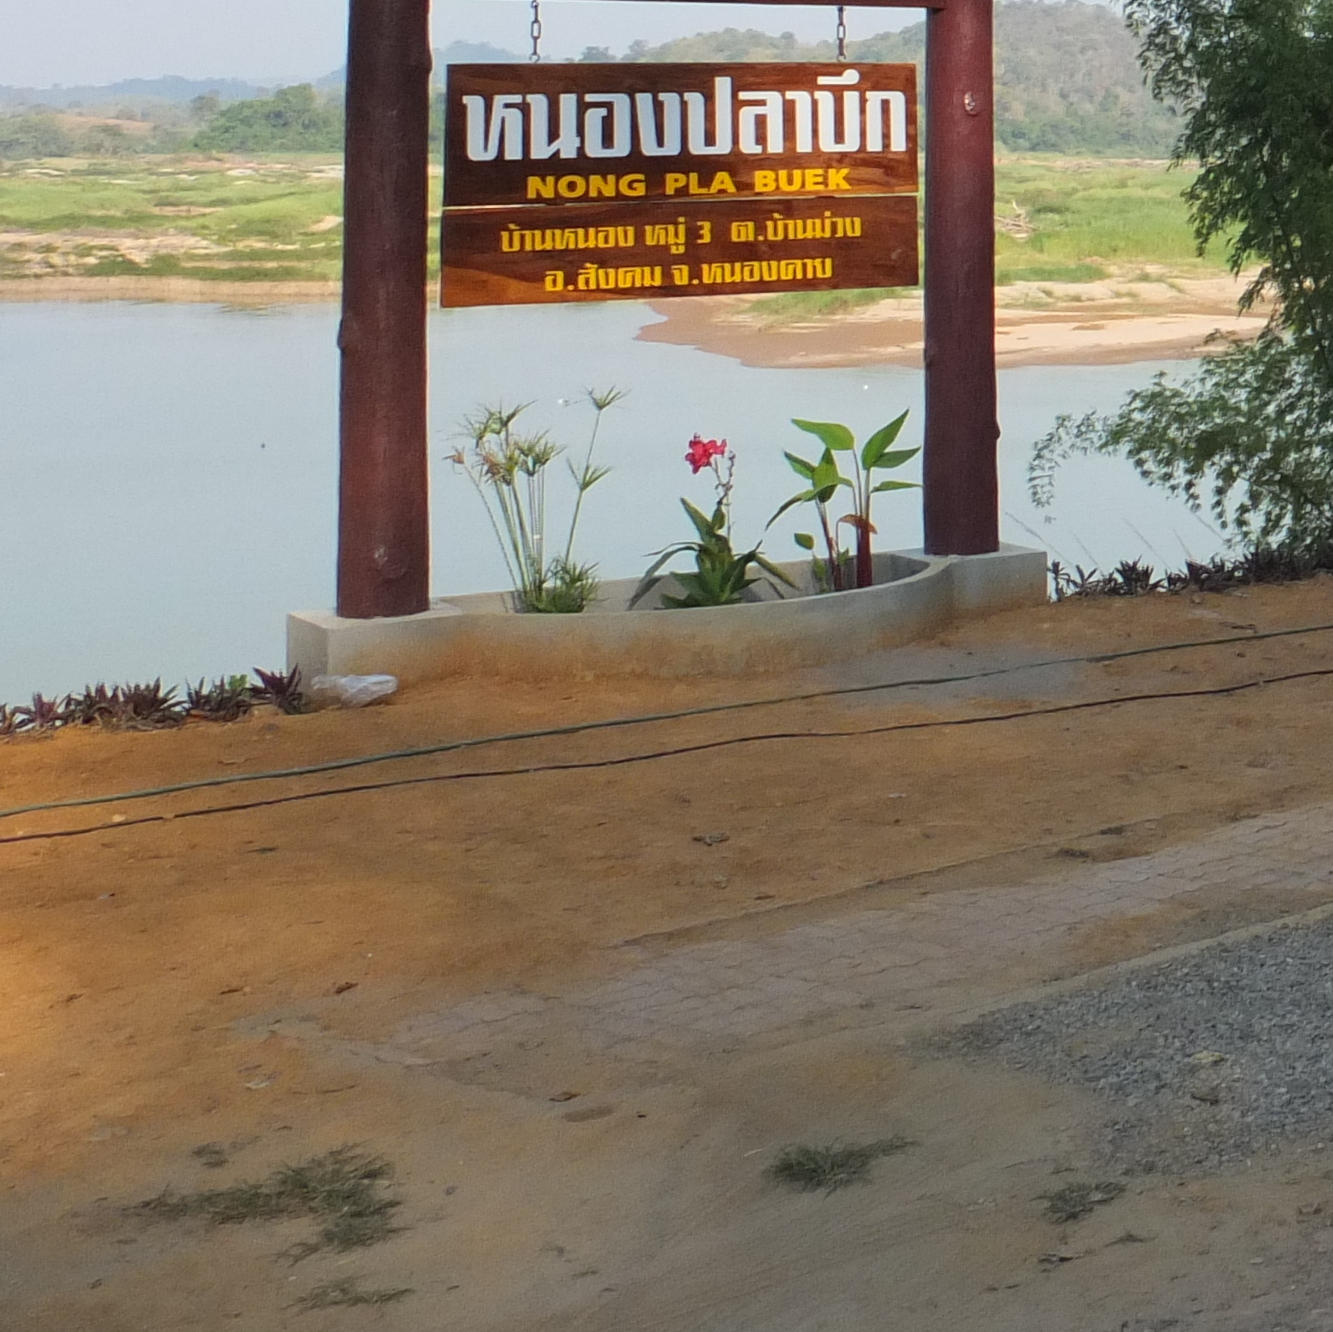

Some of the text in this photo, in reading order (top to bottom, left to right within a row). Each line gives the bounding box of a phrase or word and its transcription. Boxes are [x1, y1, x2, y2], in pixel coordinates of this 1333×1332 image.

[462, 69, 906, 162] หนองปลาบึก
[527, 169, 852, 199] NONG PLA BUEK
[501, 210, 862, 255] บ้านหนอง หมู่ 3 ต.บ้านม่วง
[670, 257, 833, 286] จ.หนองคาย
